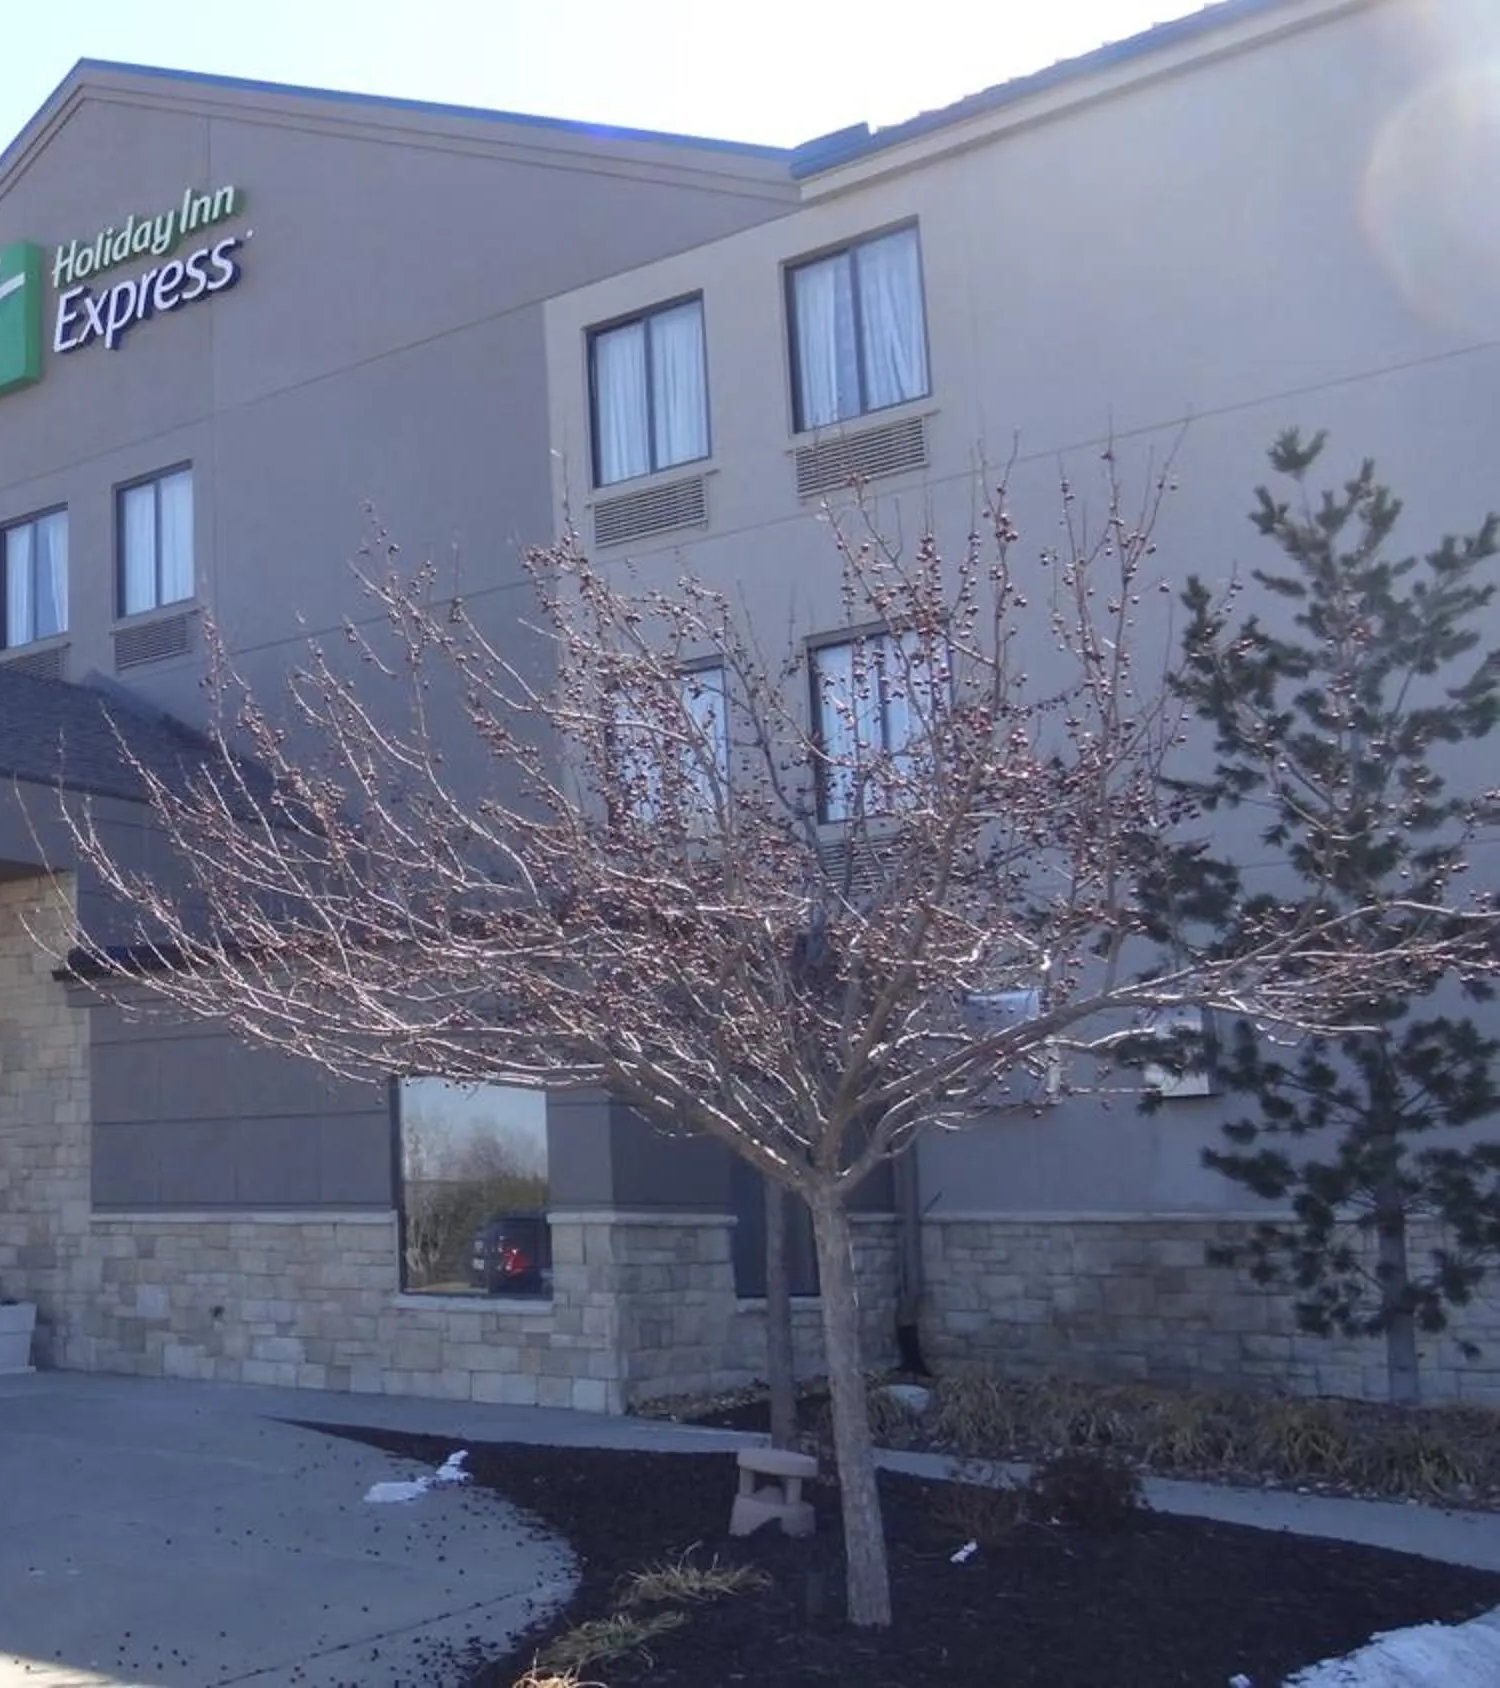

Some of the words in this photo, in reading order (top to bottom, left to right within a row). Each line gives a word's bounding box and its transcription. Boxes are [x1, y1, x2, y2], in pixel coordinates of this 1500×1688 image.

[52, 208, 175, 288] Holiday
[179, 185, 236, 234] Inn
[53, 236, 237, 353] Express
